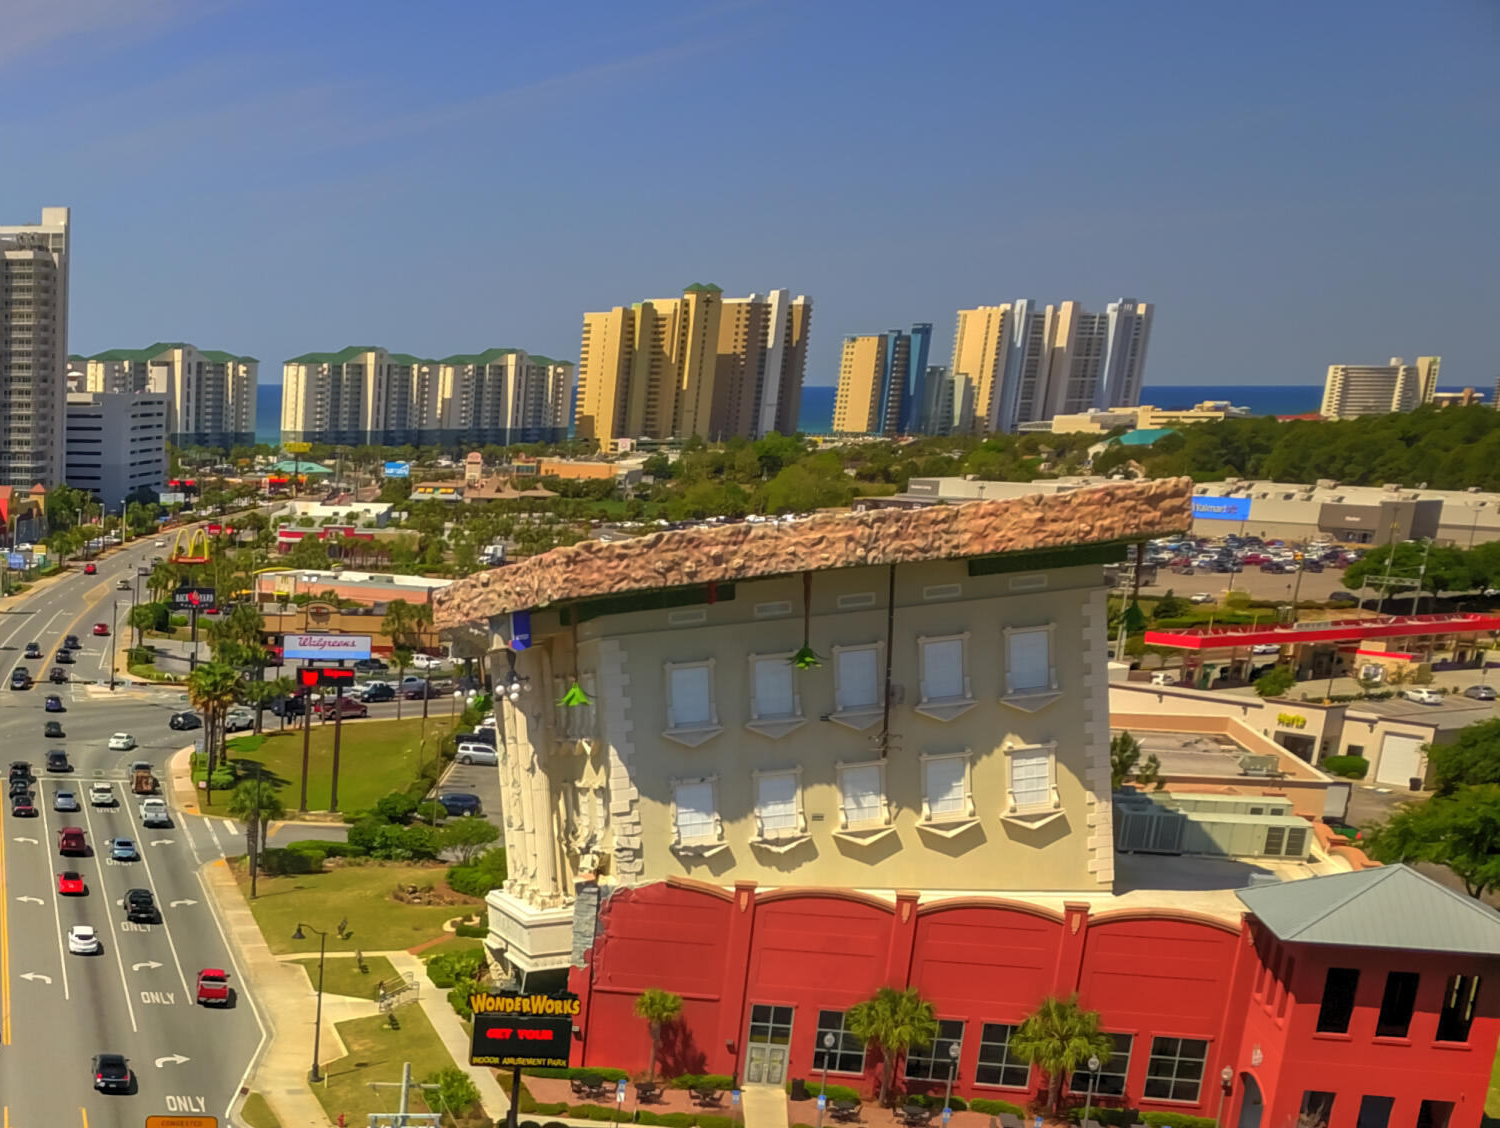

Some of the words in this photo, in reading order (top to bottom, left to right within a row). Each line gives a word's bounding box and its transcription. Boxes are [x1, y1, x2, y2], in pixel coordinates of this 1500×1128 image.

[298, 636, 357, 650] Walgreens
[1277, 713, 1306, 726] Hertz
[140, 992, 175, 1005] ONLY
[470, 993, 581, 1015] WONDERWORKS
[486, 1028, 513, 1039] GET
[517, 1029, 553, 1040] YOUR
[472, 1056, 500, 1064] INDOOR
[502, 1057, 546, 1066] AMUSEMENT
[547, 1058, 567, 1067] PARK
[165, 1096, 205, 1112] ONLY
